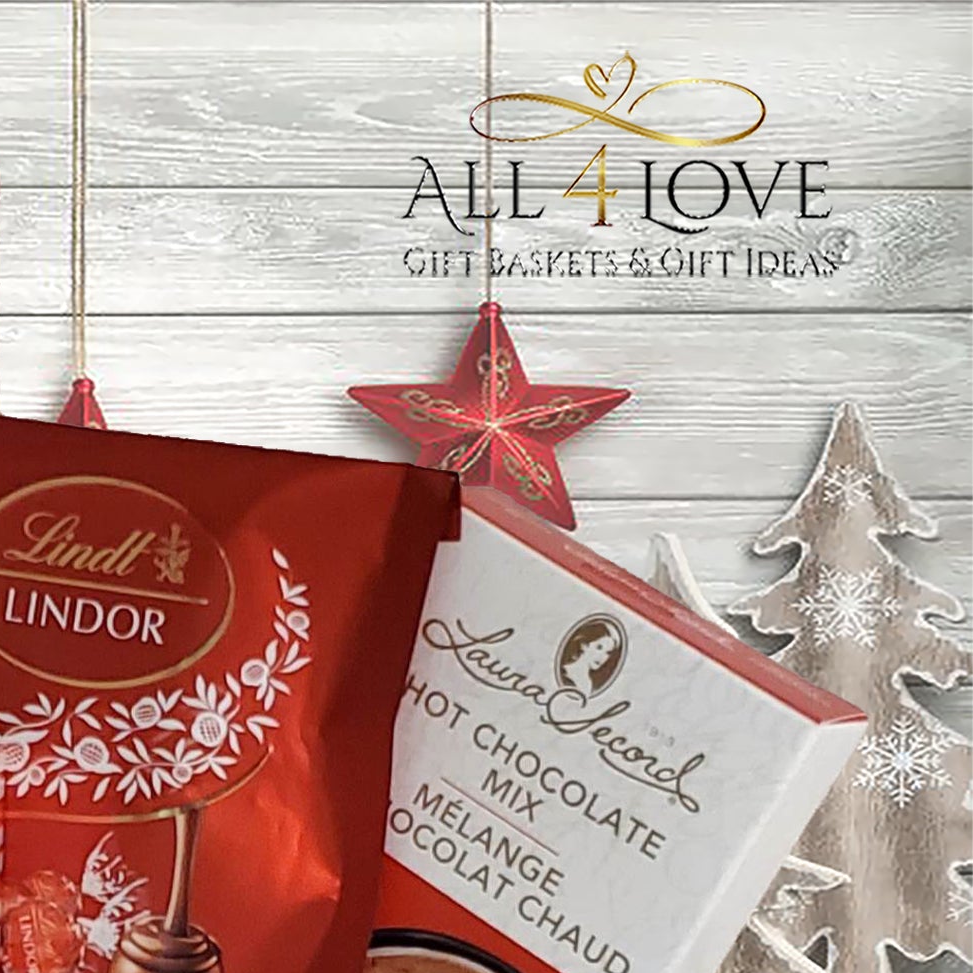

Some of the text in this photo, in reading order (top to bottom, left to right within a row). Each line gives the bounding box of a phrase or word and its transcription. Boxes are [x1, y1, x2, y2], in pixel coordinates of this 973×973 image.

[3, 511, 156, 577] Lindt
[4, 586, 166, 646] LINDOR
[422, 617, 705, 814] Laura Secord
[405, 674, 667, 861] HOT CHOCOLATE
[480, 768, 545, 823] MIX
[413, 783, 565, 898] MÉLANGE
